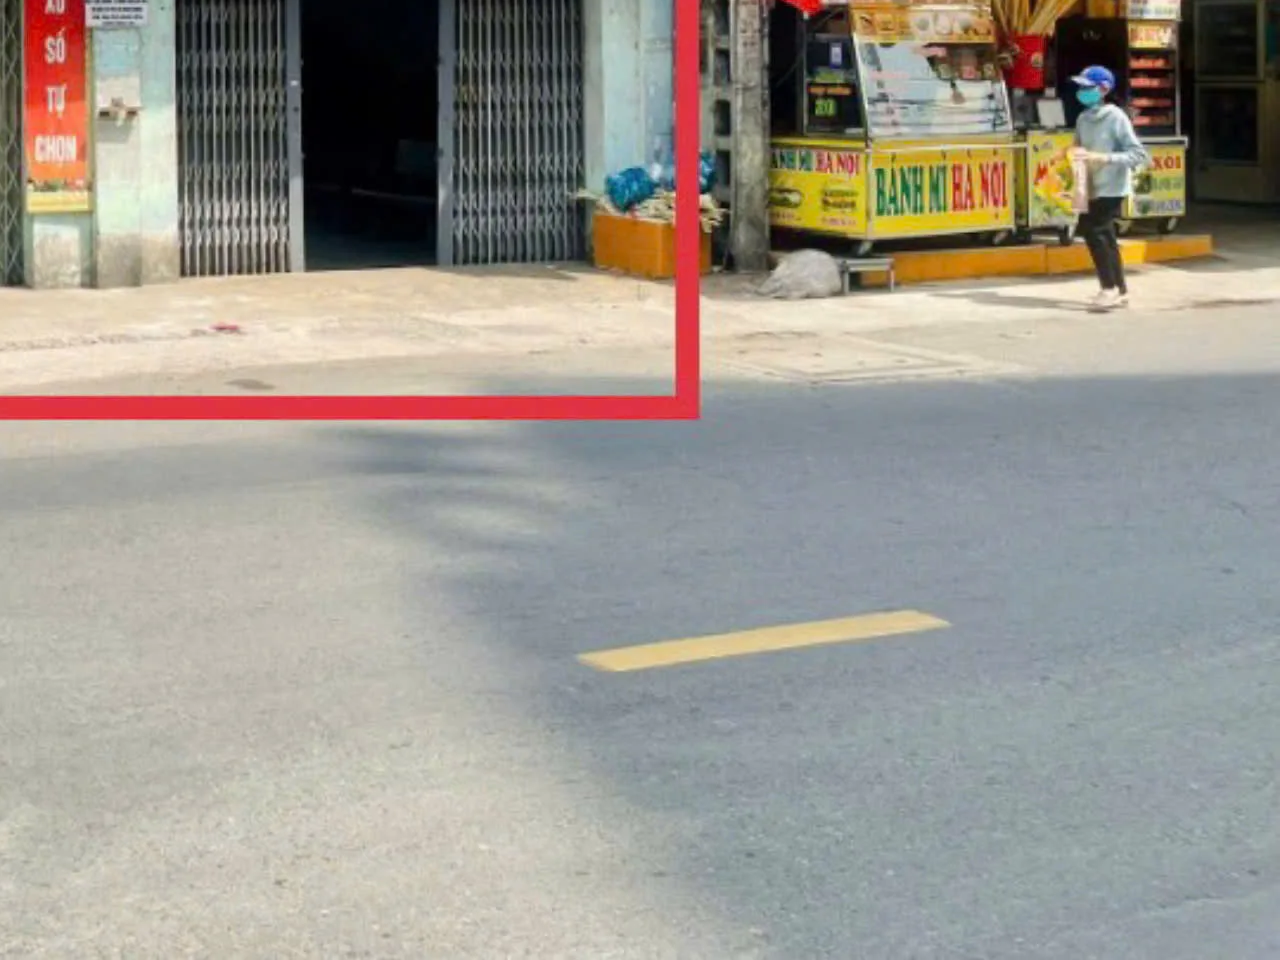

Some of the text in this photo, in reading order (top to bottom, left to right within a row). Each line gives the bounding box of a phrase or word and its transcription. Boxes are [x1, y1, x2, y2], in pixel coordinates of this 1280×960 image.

[874, 147, 1009, 220] BÁNH MÌ HÀ NỘI
